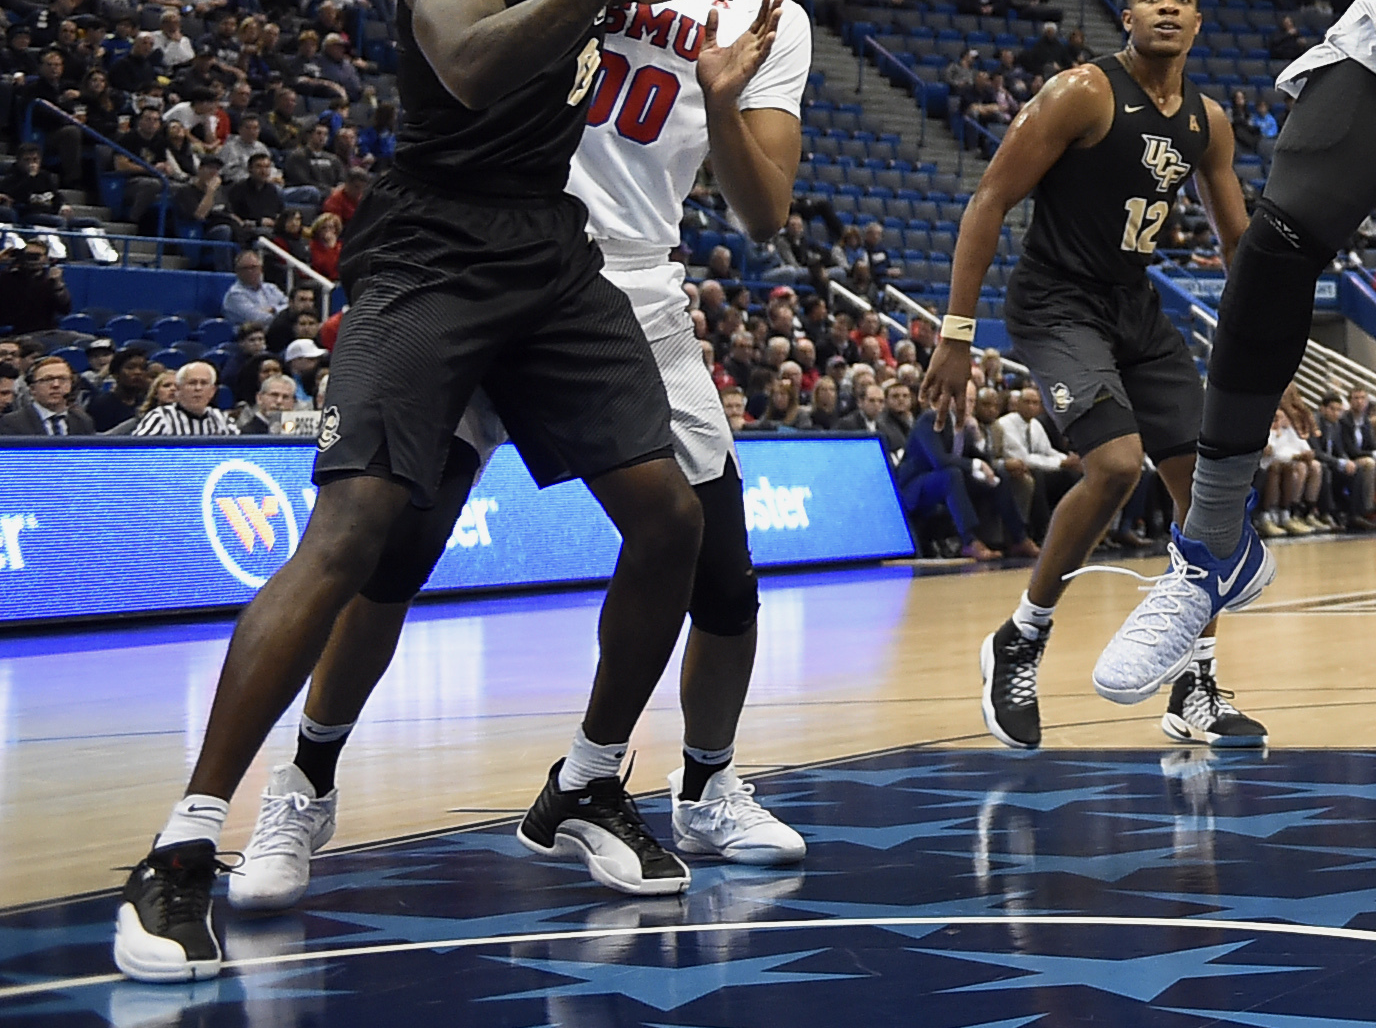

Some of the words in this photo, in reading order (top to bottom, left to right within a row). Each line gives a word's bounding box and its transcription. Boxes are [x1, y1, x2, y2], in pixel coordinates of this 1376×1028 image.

[587, 48, 681, 146] 00
[1141, 133, 1192, 193] UCF
[1120, 196, 1169, 254] 12
